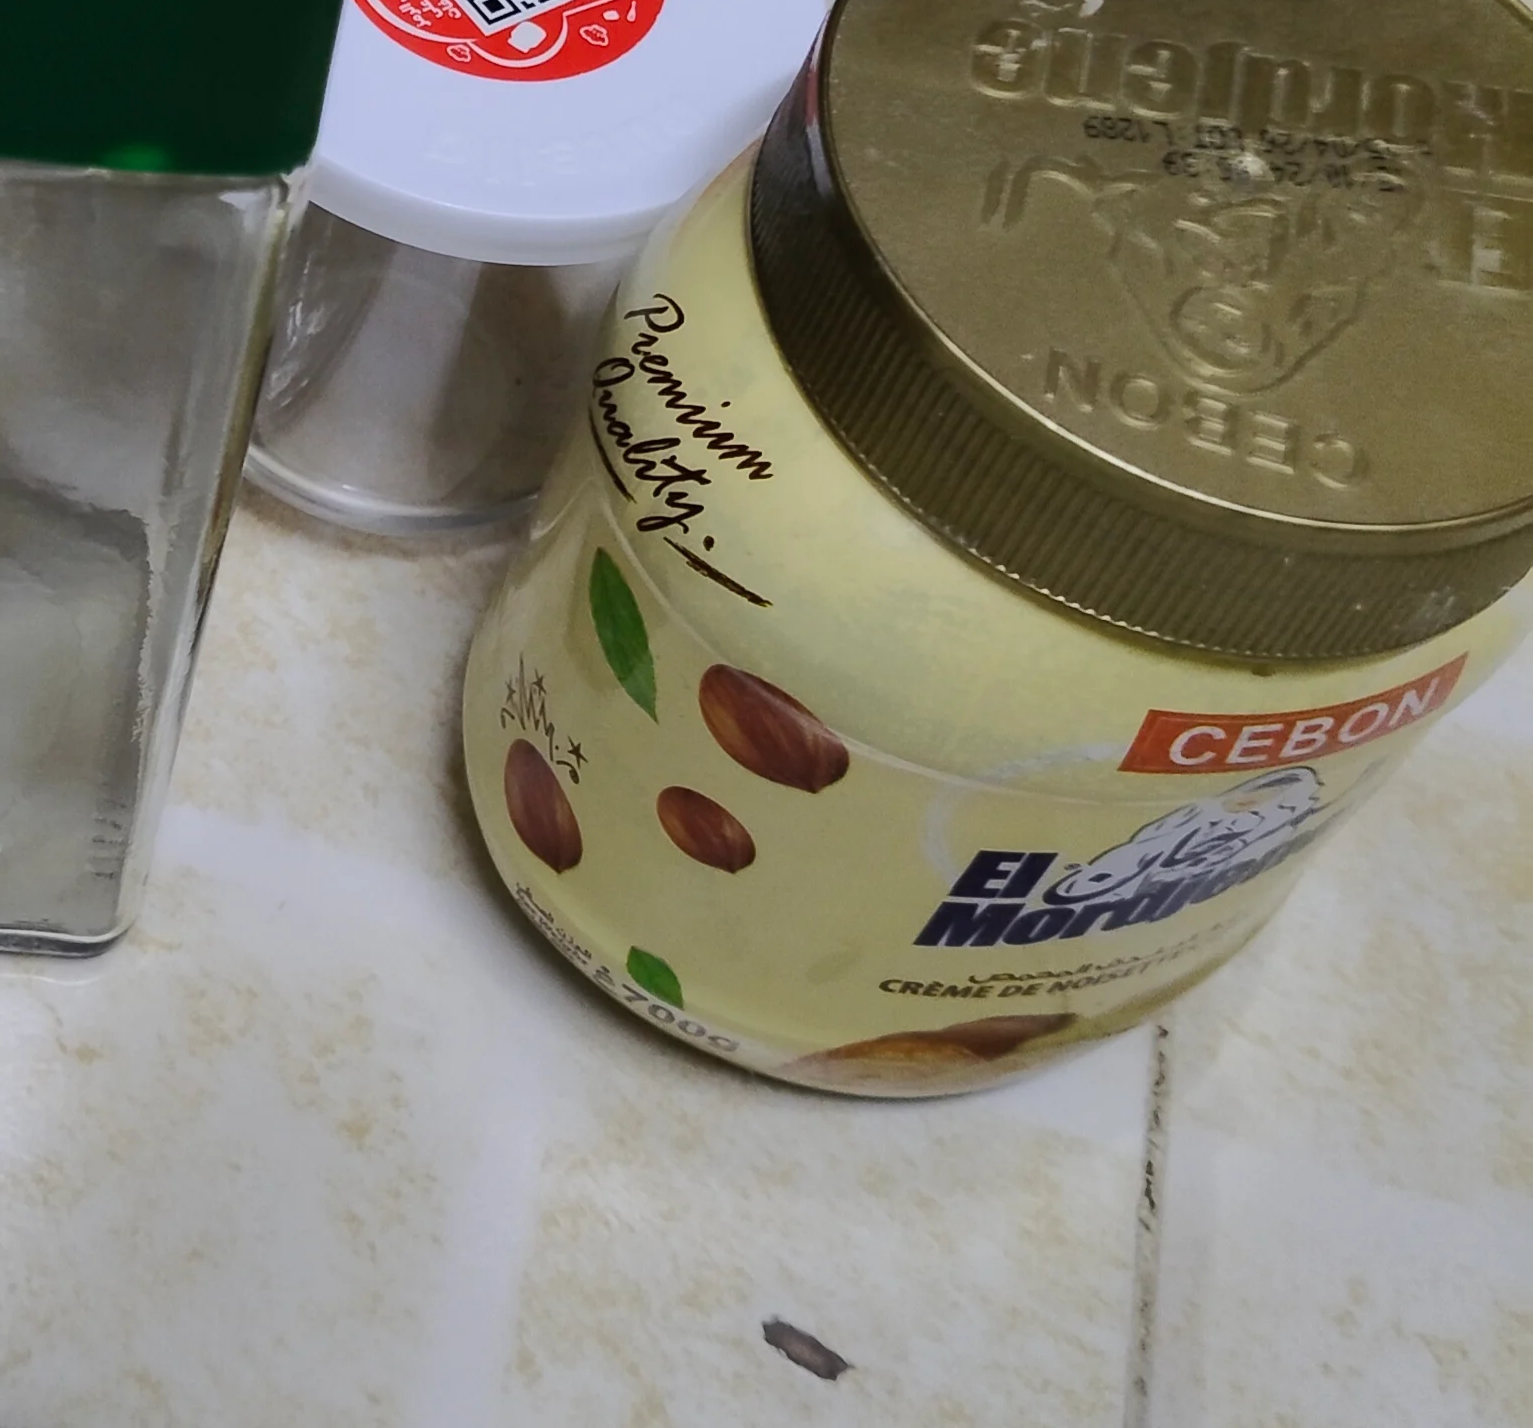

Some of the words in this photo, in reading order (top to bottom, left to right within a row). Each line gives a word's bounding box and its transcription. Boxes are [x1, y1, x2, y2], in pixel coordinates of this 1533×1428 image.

[398, 1, 432, 29] الرمز
[624, 292, 775, 482] Premium
[1043, 345, 1374, 491] CEBON
[1168, 676, 1440, 766] CEBON
[948, 848, 1060, 899] El
[879, 977, 995, 1000] CRÈME
[997, 980, 1051, 999] DE
